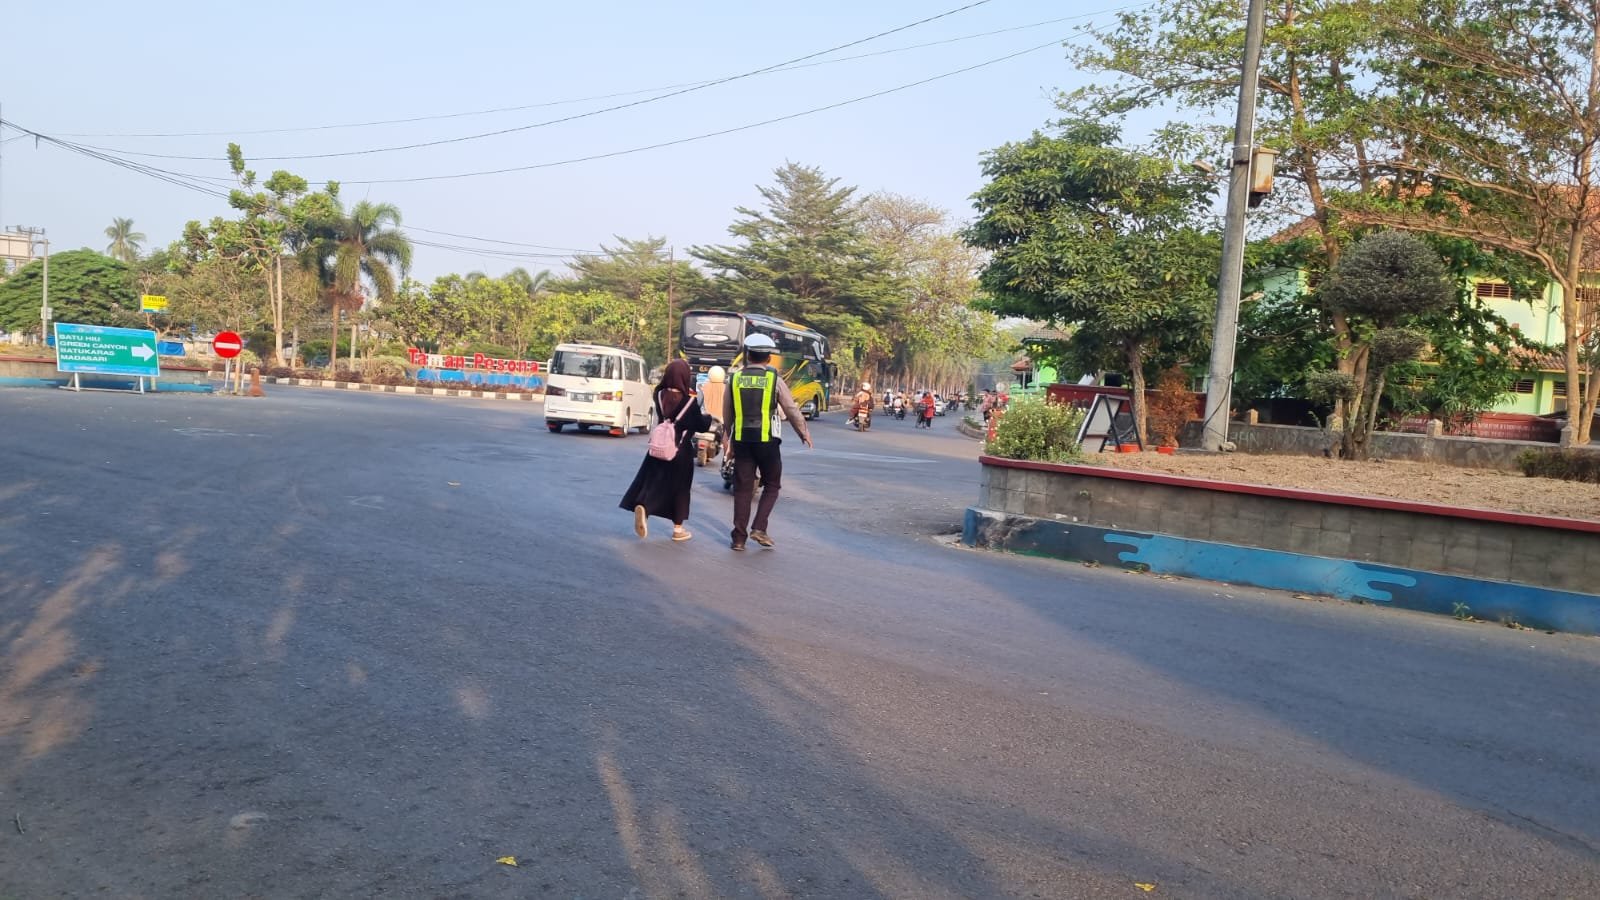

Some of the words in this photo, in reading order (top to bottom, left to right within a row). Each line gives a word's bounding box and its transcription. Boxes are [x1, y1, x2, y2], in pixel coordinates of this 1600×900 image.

[59, 347, 115, 356] BATUKARAS
[60, 354, 107, 362] MADASARI
[474, 352, 539, 373] Pesona
